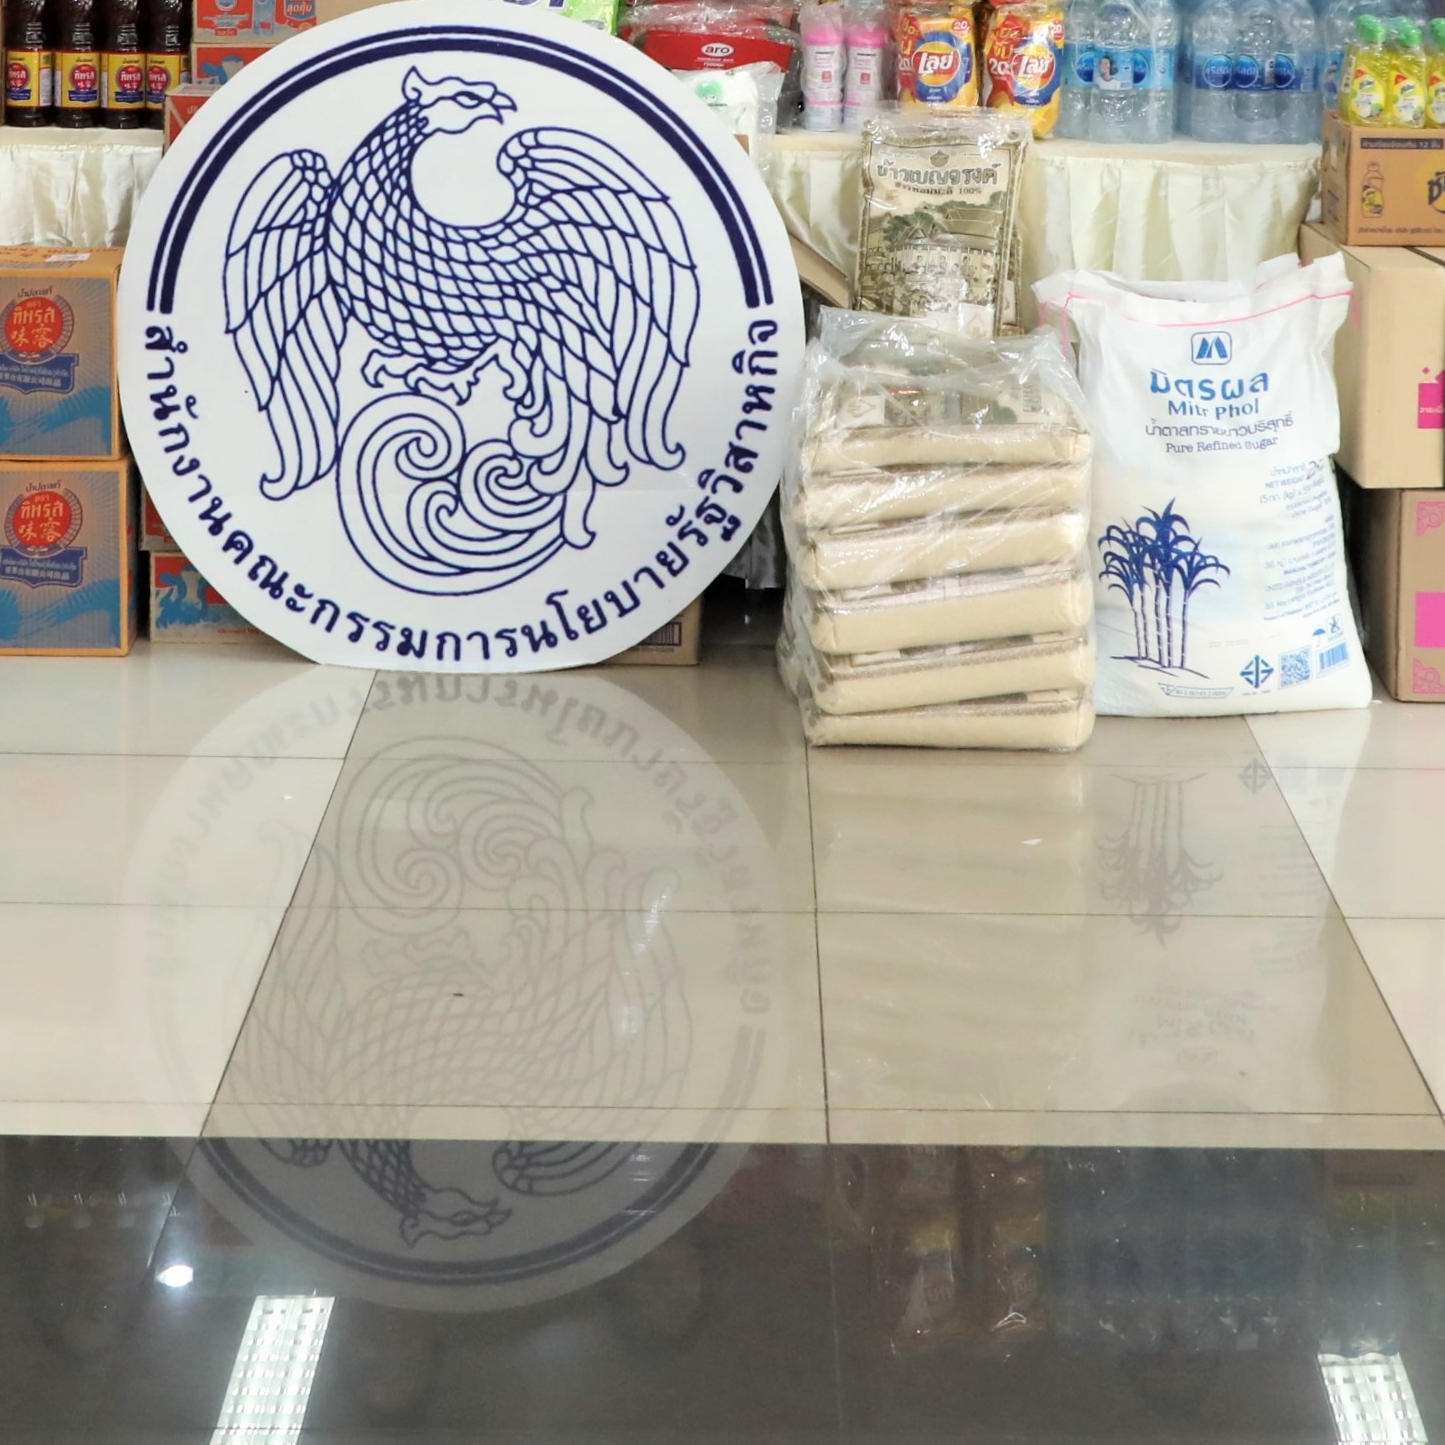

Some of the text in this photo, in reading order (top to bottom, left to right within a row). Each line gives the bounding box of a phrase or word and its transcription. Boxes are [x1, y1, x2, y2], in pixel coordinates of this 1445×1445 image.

[705, 45, 730, 54] aro
[13, 306, 56, 325] ทิพรส
[1149, 367, 1269, 401] มิตรผล
[1165, 442, 1193, 453] Pure
[1196, 439, 1243, 452] Refined
[144, 319, 779, 661] สำนักงานคณะกรรมการนโยบายรัฐวิสาหกิจ
[21, 500, 64, 519] ทิพรส
